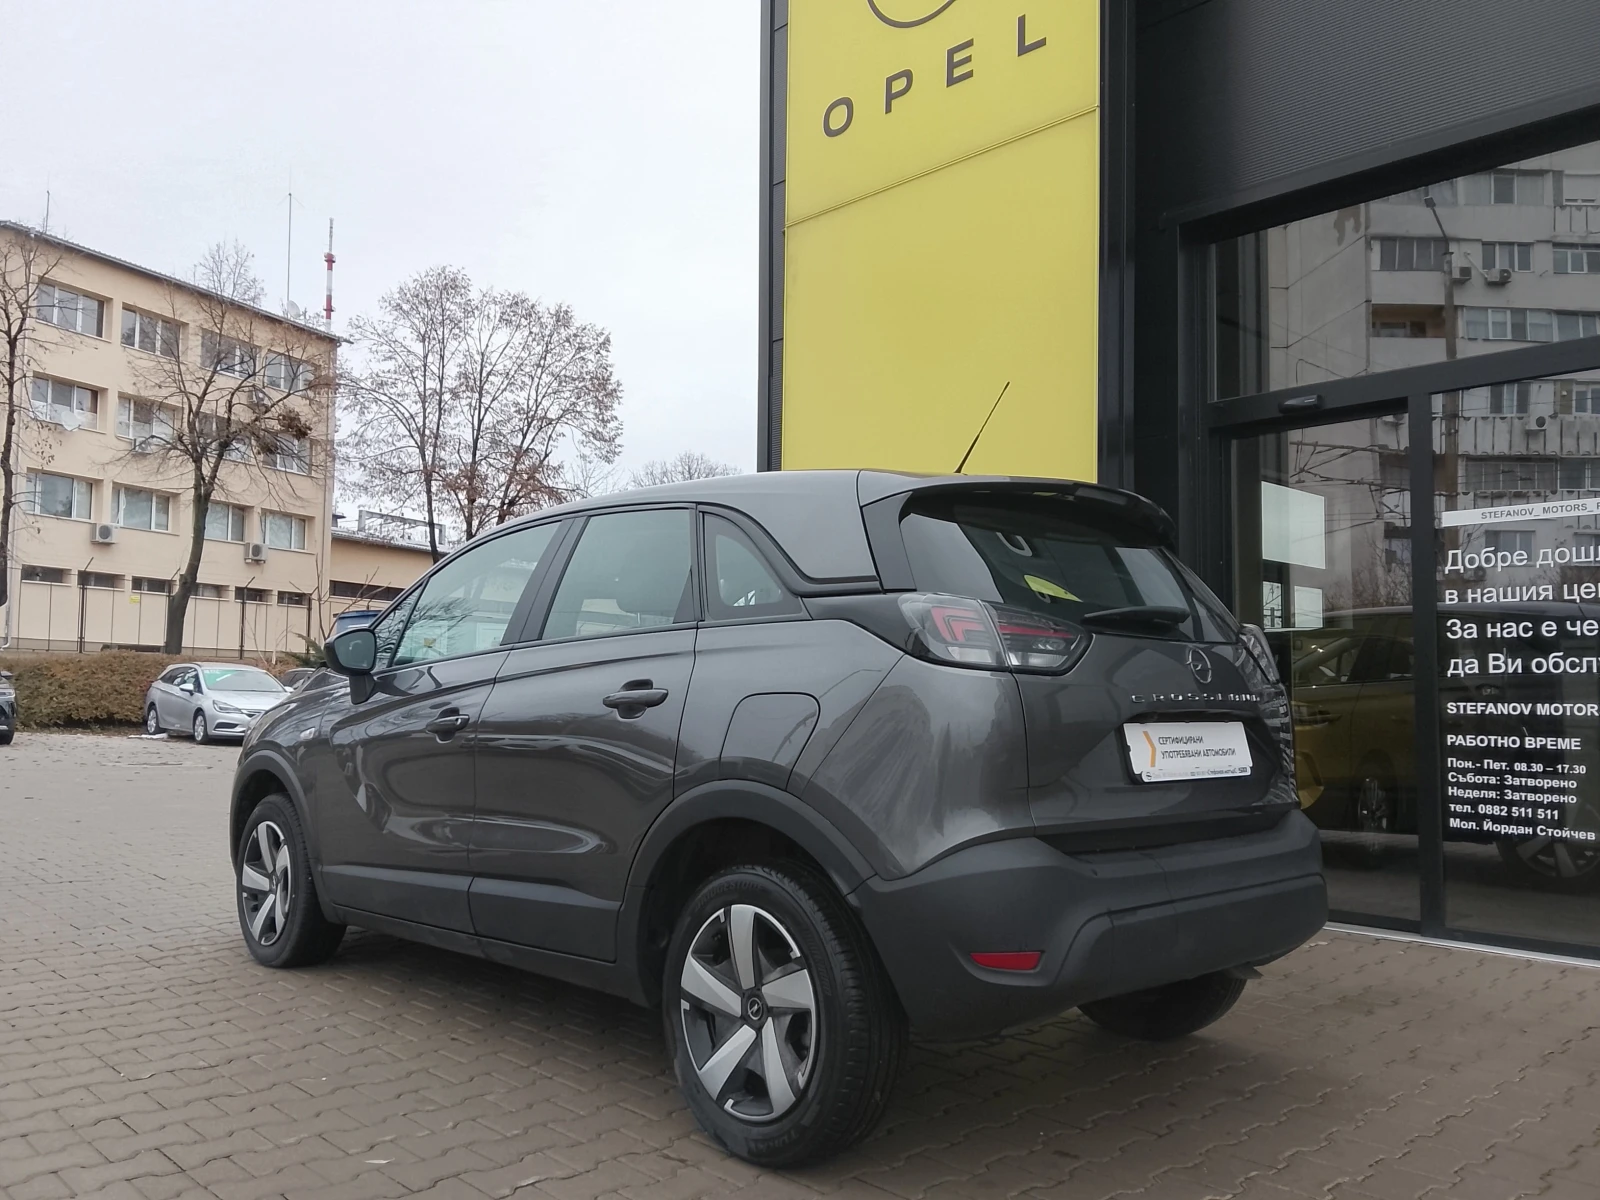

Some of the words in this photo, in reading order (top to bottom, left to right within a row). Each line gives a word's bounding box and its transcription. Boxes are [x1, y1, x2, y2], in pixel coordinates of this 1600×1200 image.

[822, 14, 1047, 138] OPEL
[1444, 546, 1528, 574] Добре
[1536, 545, 1600, 569] дош
[1444, 589, 1459, 604] в
[1467, 584, 1553, 604] нашия
[1563, 582, 1600, 603] це
[1446, 618, 1478, 639] За
[1486, 621, 1534, 639] нас
[1541, 620, 1558, 637] е
[1447, 657, 1480, 677] да
[1488, 652, 1523, 674] Ви
[1531, 652, 1600, 674] обсл
[1446, 702, 1533, 715] STEFANOV
[1536, 703, 1600, 716] MOTOR
[1446, 734, 1521, 748] РАБОТНО
[1525, 736, 1582, 750] ВРЕМЕ
[1484, 759, 1510, 771] Пет.
[1514, 762, 1544, 773] 08.30
[1556, 764, 1587, 775] 17.30
[1447, 772, 1501, 785] Събота:
[1503, 775, 1578, 790] Затворено
[1447, 786, 1501, 799] Неделя:
[1503, 789, 1577, 804] Затворено
[1449, 803, 1475, 814] тел.
[1478, 804, 1508, 817] 0882
[1511, 807, 1532, 819] 511
[1537, 809, 1559, 821] 511
[1449, 818, 1480, 831] Мол.
[1483, 819, 1533, 836] Йордан
[1536, 825, 1597, 841] Стойчев
